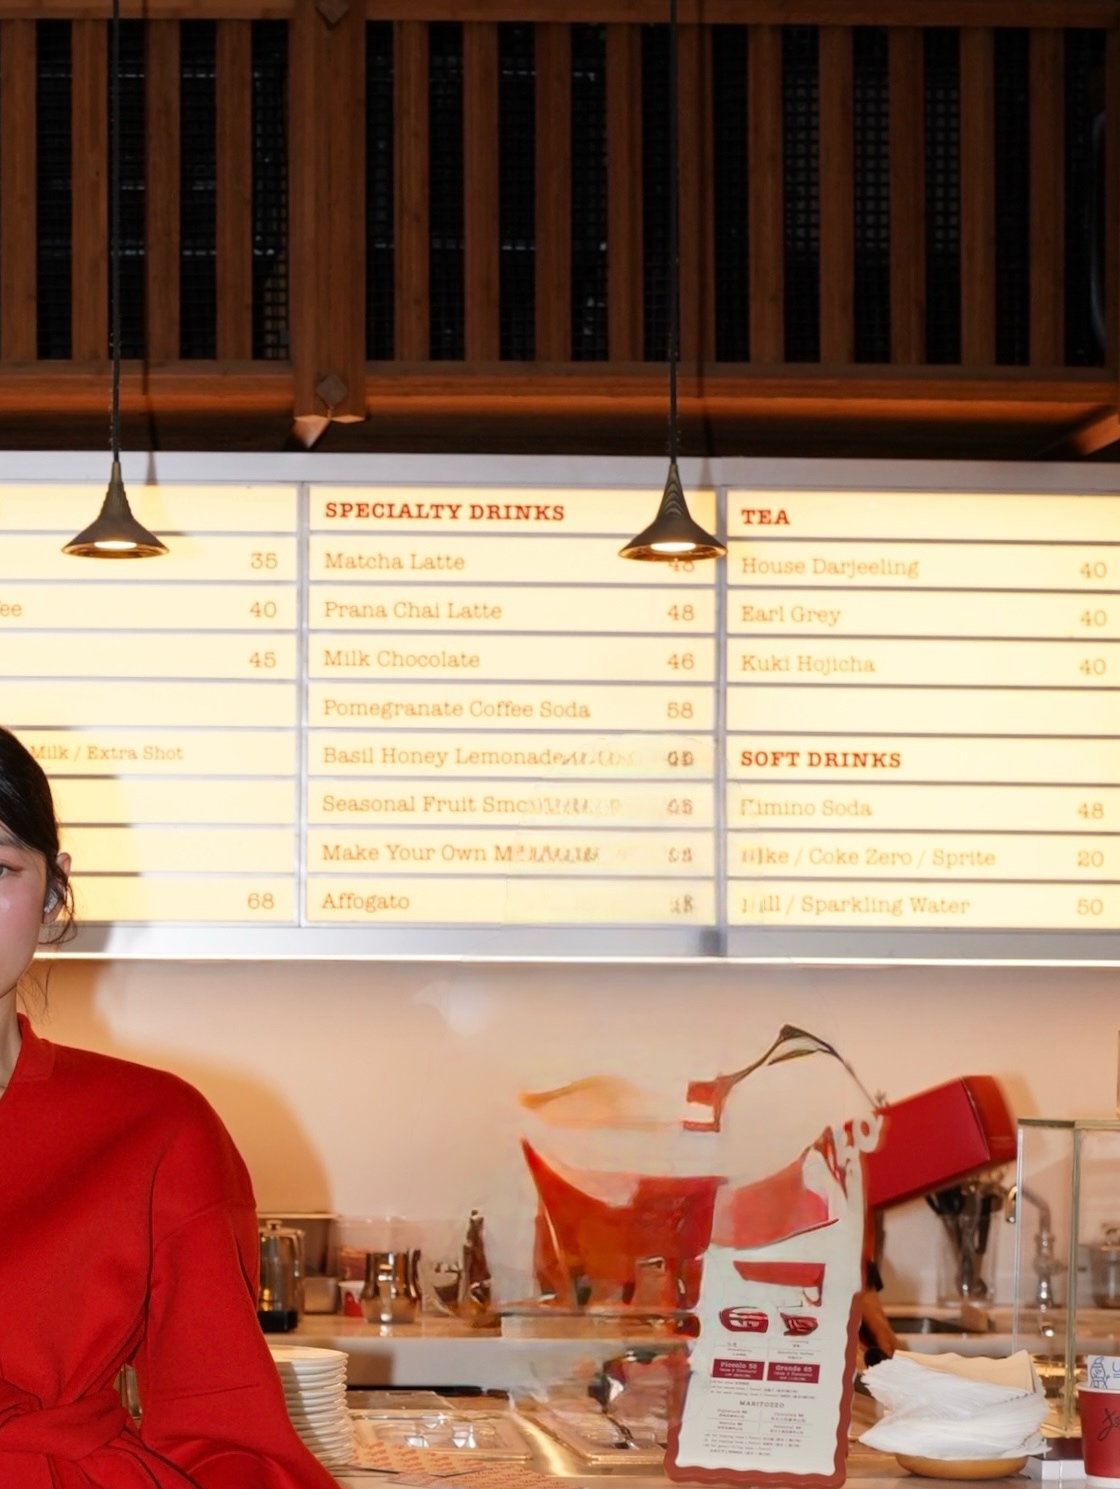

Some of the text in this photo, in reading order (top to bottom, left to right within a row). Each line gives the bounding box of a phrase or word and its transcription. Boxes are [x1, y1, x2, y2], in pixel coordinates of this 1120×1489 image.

[325, 502, 564, 521] SPECIALTY DRINKS
[741, 509, 790, 525] TEA
[250, 552, 278, 569] 35
[324, 552, 404, 570] Matcha
[410, 553, 465, 570] Latte
[741, 557, 1107, 579] House Darjeeling 40
[249, 601, 277, 618] 40
[324, 601, 695, 621] Prana Chai Latte 48
[741, 604, 1107, 627] Earl Grey 40
[249, 651, 276, 668] 45
[323, 650, 695, 670] Milk Chocolate 46
[741, 654, 1106, 676] Kuki Hojicha 40
[323, 699, 694, 720] Pomegranate Coffee Soda 58
[30, 745, 69, 760] Milk
[86, 745, 138, 762] Extra
[142, 745, 184, 760] Shot
[323, 746, 374, 764] Basil
[381, 747, 449, 768] Honey
[455, 749, 563, 765] Lemonade
[740, 751, 900, 768] SOFT DRINKS
[322, 794, 416, 812] Seasonal
[422, 795, 476, 813] Fruit
[822, 799, 872, 817] Soda
[1077, 802, 1104, 819] 48
[322, 844, 379, 861] Make
[385, 844, 436, 861] Your
[441, 844, 487, 862] Own
[808, 848, 859, 865] Coke
[865, 848, 912, 865] Zero
[932, 848, 996, 870] Sprite
[1077, 850, 1104, 868] 20
[247, 893, 275, 910] 68
[321, 892, 410, 913] Affogato
[801, 894, 903, 917] Sparkling
[909, 896, 970, 914] Water
[1077, 898, 1104, 916] 50
